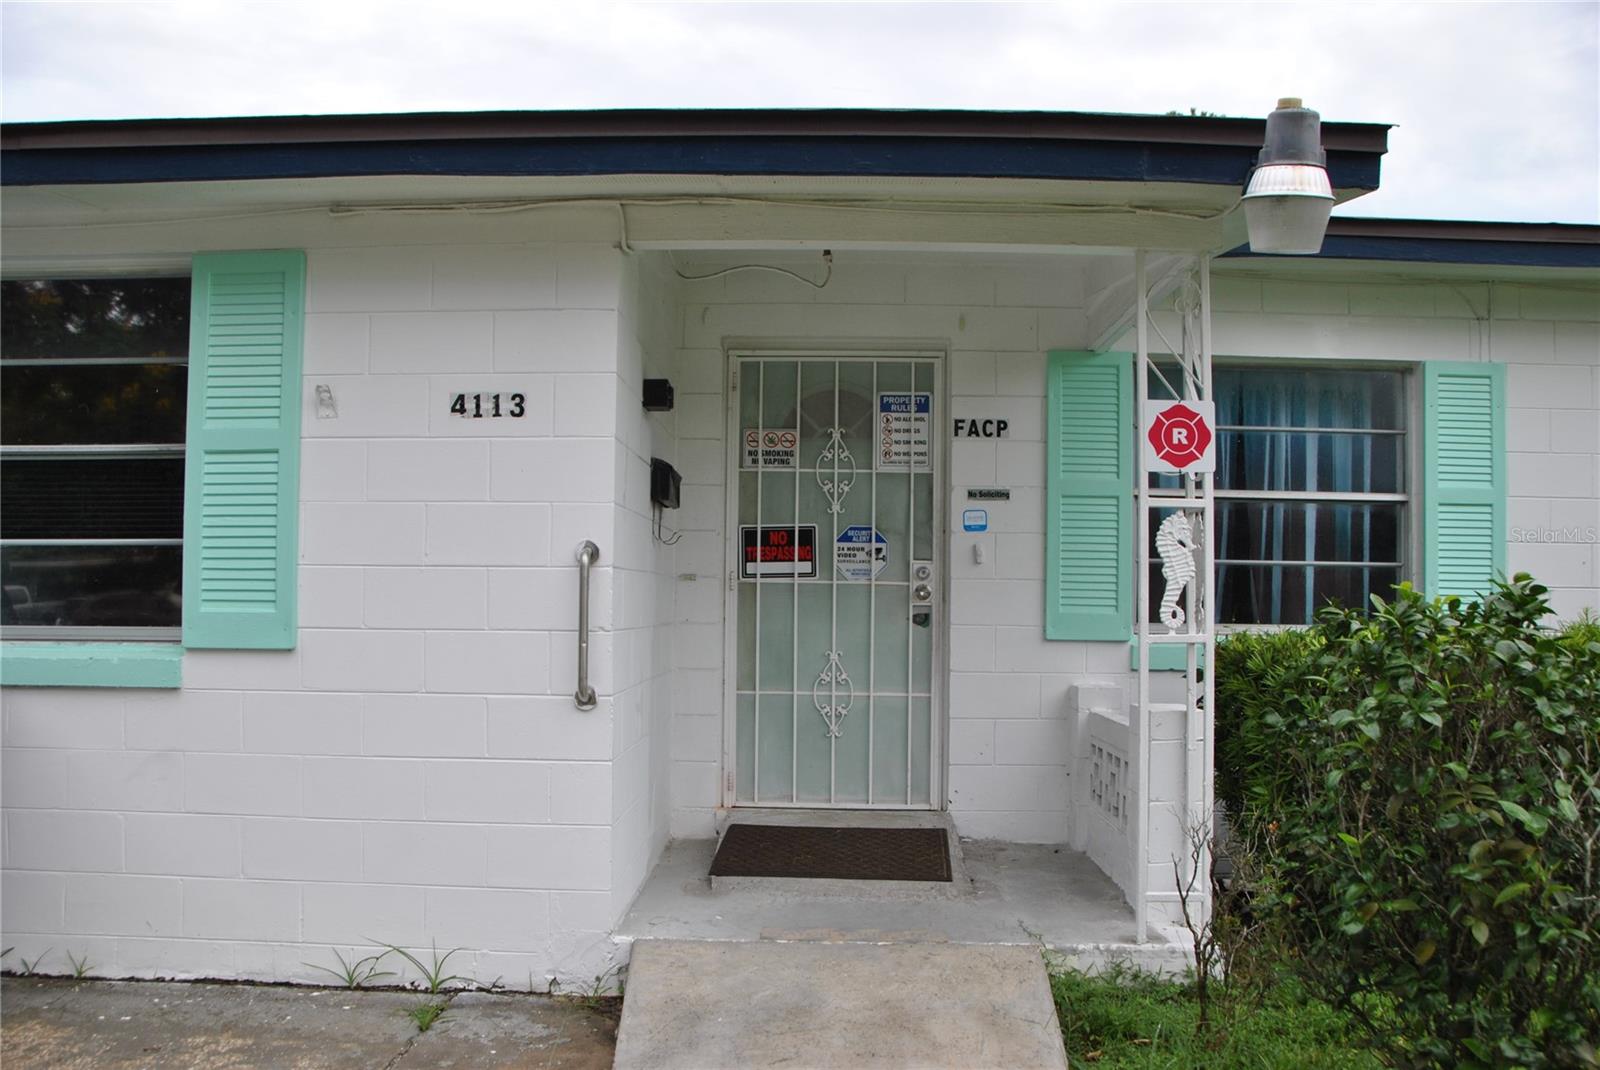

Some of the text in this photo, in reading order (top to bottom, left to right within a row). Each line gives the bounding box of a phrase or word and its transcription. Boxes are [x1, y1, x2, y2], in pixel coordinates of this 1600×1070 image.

[450, 393, 525, 418] 4113
[883, 396, 926, 404] PROPETY
[954, 419, 1008, 438] FACP
[1172, 428, 1188, 445] R
[768, 530, 788, 545] NO
